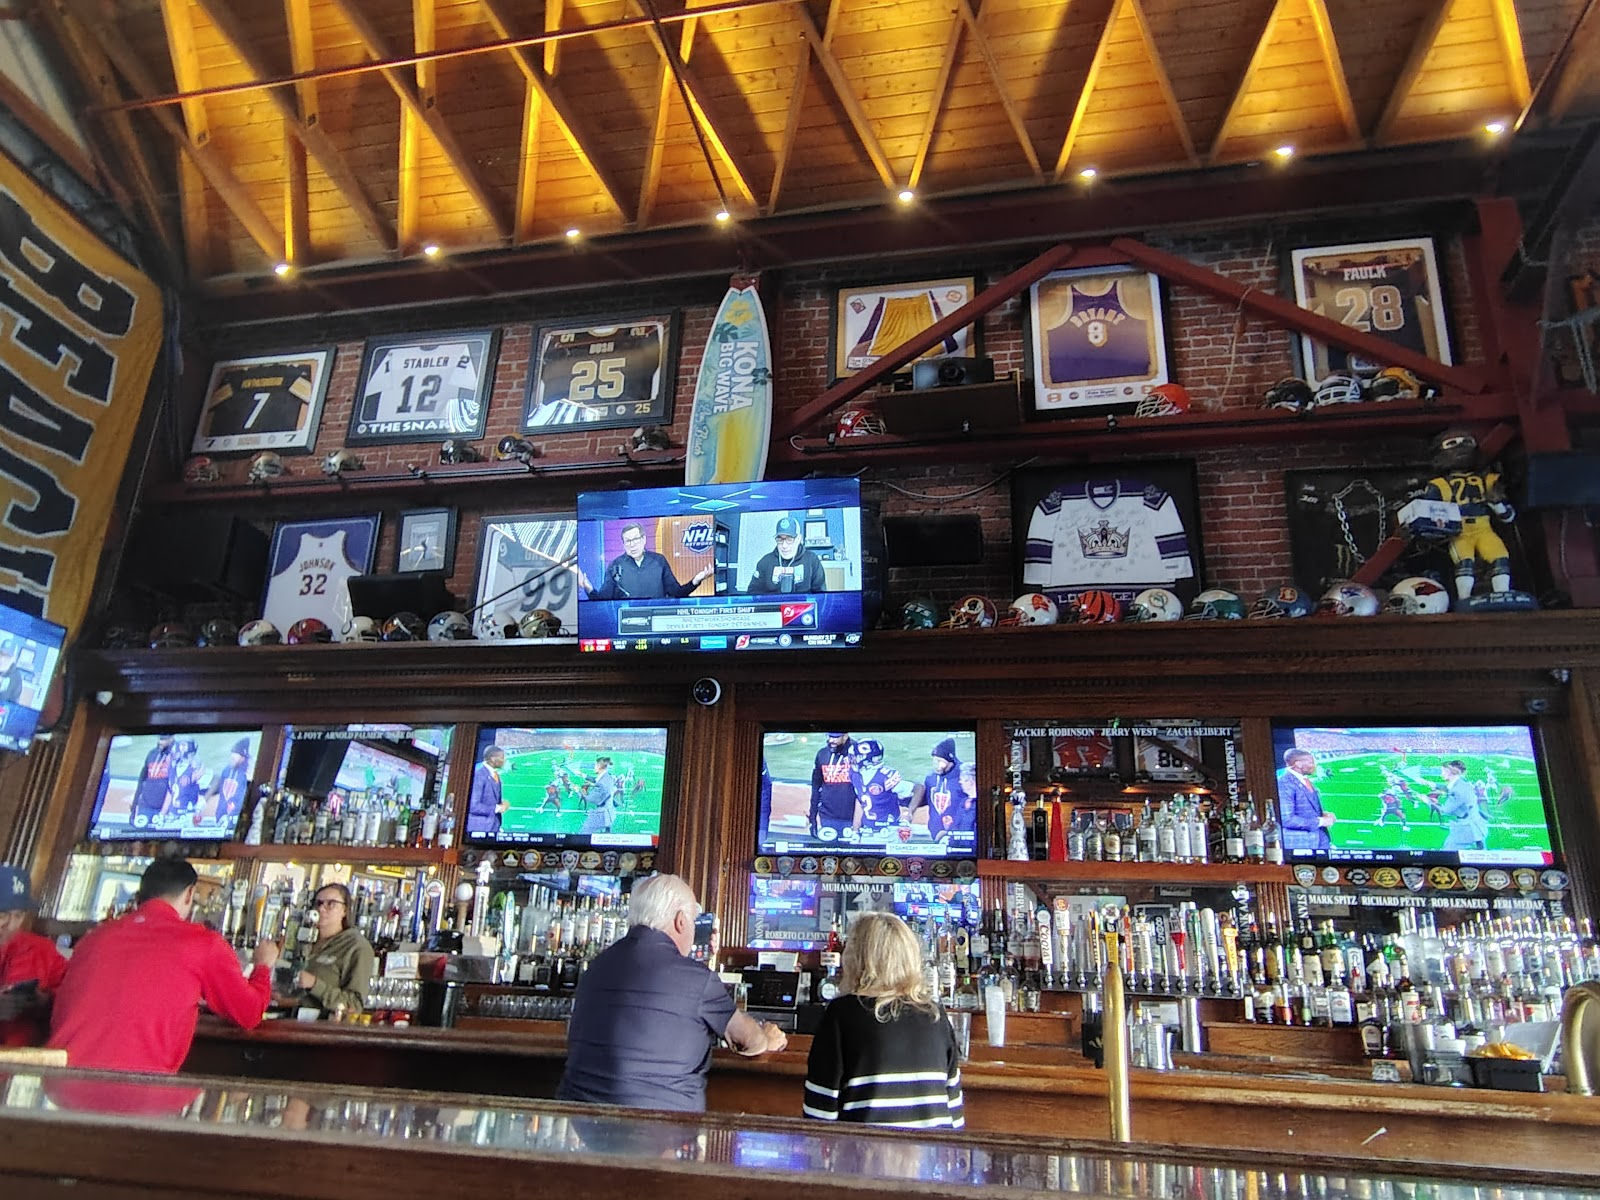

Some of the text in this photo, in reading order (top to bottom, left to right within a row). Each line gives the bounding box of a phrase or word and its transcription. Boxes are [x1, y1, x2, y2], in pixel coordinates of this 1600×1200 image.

[1343, 265, 1387, 281] FAULK
[1069, 307, 1126, 328] BRYANT
[1336, 285, 1405, 332] 28
[1087, 322, 1108, 347] 8
[403, 356, 450, 369] STABLER
[569, 358, 626, 401] 25
[713, 342, 734, 414] BIG WAVE
[730, 341, 759, 412] KONA
[396, 374, 442, 414] 12
[243, 392, 271, 429] 7
[634, 403, 651, 414] 25
[368, 419, 453, 434] THE SNAK
[682, 528, 715, 543] NHL
[299, 557, 336, 572] JOHNSON
[299, 574, 328, 596] 32
[520, 568, 573, 612] 99
[1057, 593, 1080, 604] LO
[1014, 727, 1232, 737] JACKIE ROBINSON JERRY WEST ZACH SEIBERT
[1011, 763, 1022, 789] NICKL
[1225, 739, 1240, 807] JACK DEMPSEY
[821, 883, 870, 893] MUHAMMAD
[871, 884, 885, 893] ALI
[1015, 882, 1025, 909] JERRY
[1236, 881, 1249, 912] AAO
[1297, 894, 1309, 919] STAN
[1308, 895, 1333, 905] MARK
[1334, 895, 1358, 905] SPITZ
[1361, 896, 1399, 906] RICHARD
[1400, 897, 1427, 907] PETTY
[1431, 898, 1449, 908] ROB
[1450, 898, 1489, 909] LENAEUS
[765, 930, 831, 941] ROBERTO CLEMENT
[1155, 916, 1165, 942] 805
